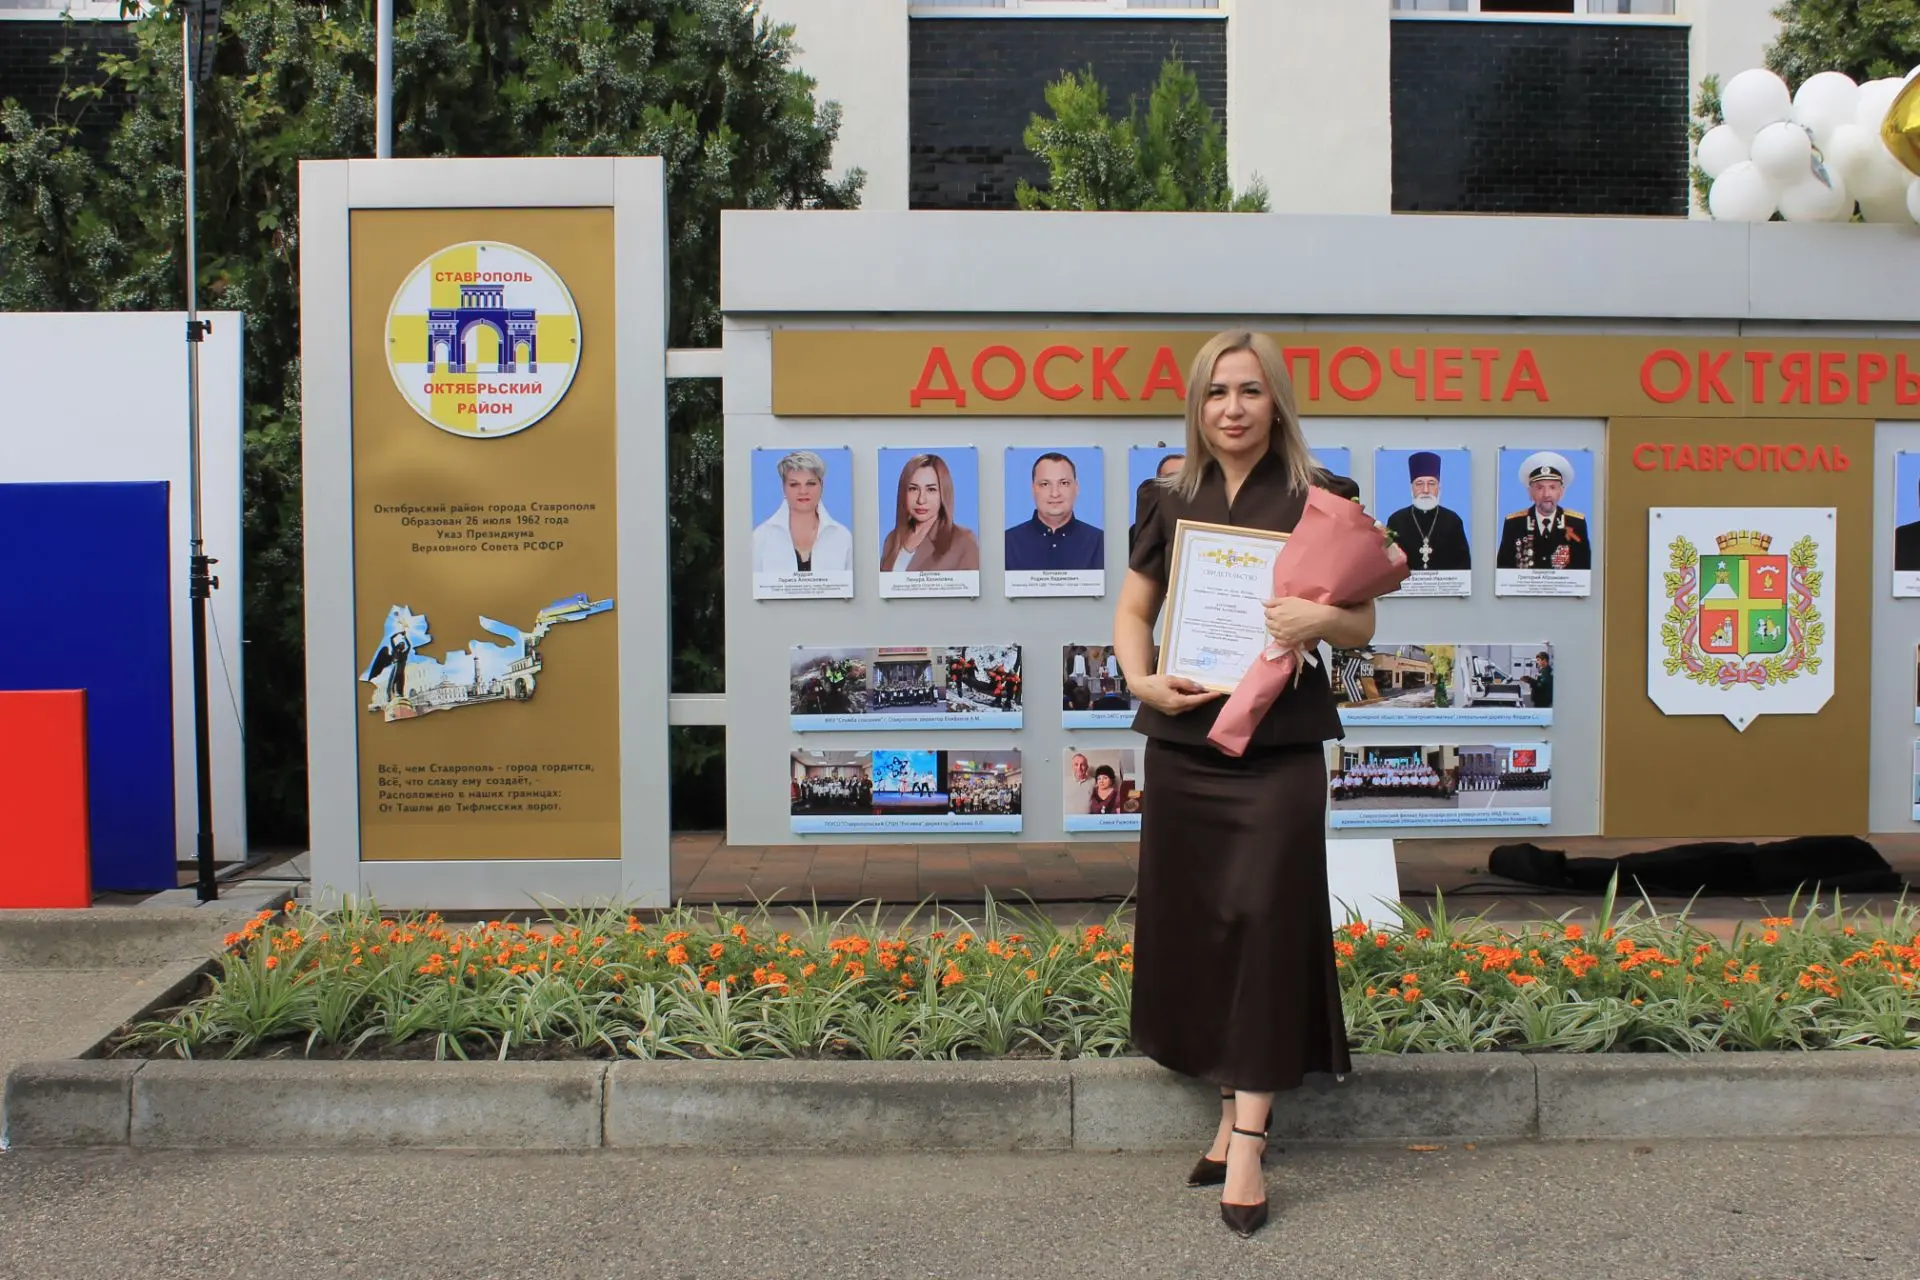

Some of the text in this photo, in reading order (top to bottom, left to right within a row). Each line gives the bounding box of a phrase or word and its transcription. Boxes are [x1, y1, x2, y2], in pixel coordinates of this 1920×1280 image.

[435, 271, 533, 283] СТАВРОПОЛЬ
[910, 345, 1187, 408] ДОСКА
[1285, 346, 1549, 403] ПОЧЕТА
[424, 380, 543, 395] ОКТЯБРЬСКИЙ
[457, 401, 513, 414] РАЙОН
[1632, 442, 1851, 472] СТАВРОПОЛЬ
[374, 502, 596, 515] Октябрьский район города Ставрополя
[401, 515, 569, 527] Образован 26 июля 1962 года
[437, 529, 535, 540] Указ Президиума
[412, 541, 563, 554] Верховного Совета РСФСР
[378, 763, 402, 775] Всё,
[405, 765, 426, 774] чем
[430, 763, 495, 774] Ставрополь
[505, 764, 538, 774] город
[541, 764, 595, 774] гордится,
[378, 776, 402, 787] Всё,
[406, 778, 424, 786] что
[428, 778, 458, 788] славу
[461, 778, 482, 788] ему
[486, 776, 532, 786] создаёт,
[378, 789, 562, 800] Расположено в наших границах:
[378, 802, 561, 813] От Ташлы до Тифлисских ворот.
